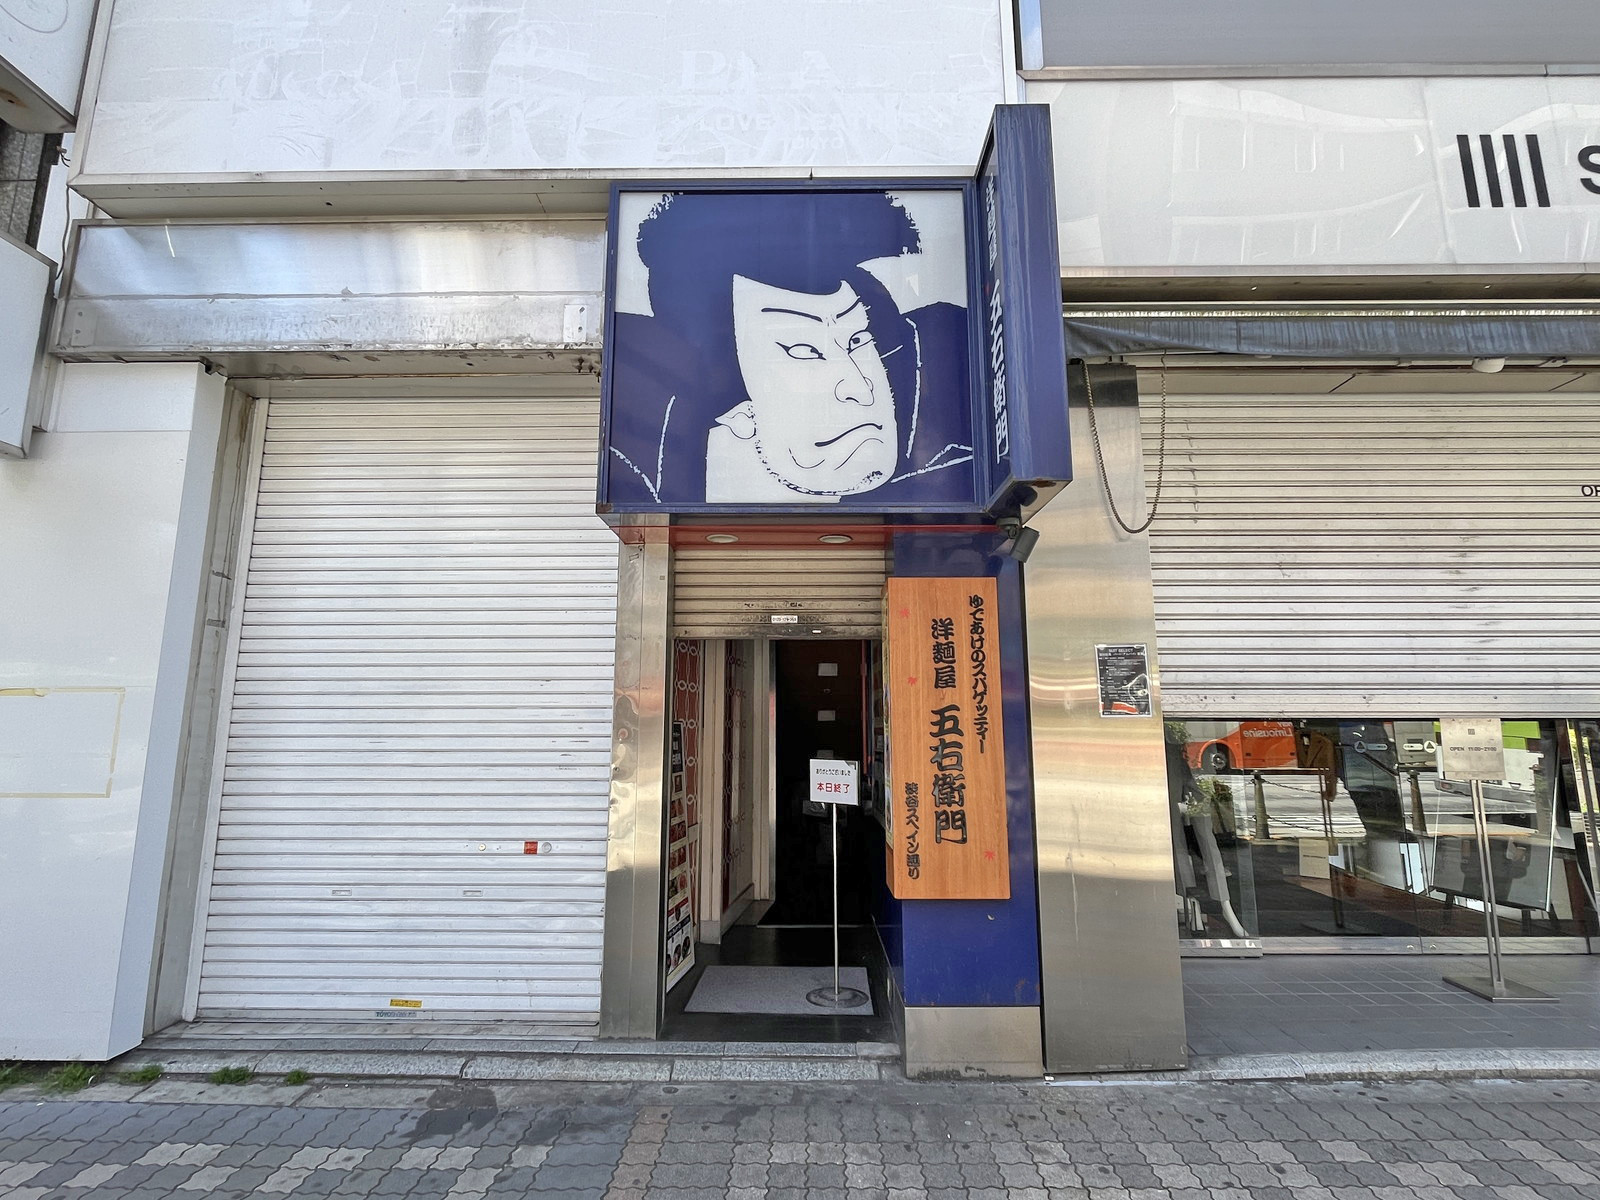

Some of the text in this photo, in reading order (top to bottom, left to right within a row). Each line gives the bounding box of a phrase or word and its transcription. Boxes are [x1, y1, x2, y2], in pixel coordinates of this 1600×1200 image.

[989, 278, 1010, 465] 五右衛門
[817, 782, 850, 793] 本日終了
[930, 704, 967, 845] 五右衛門
